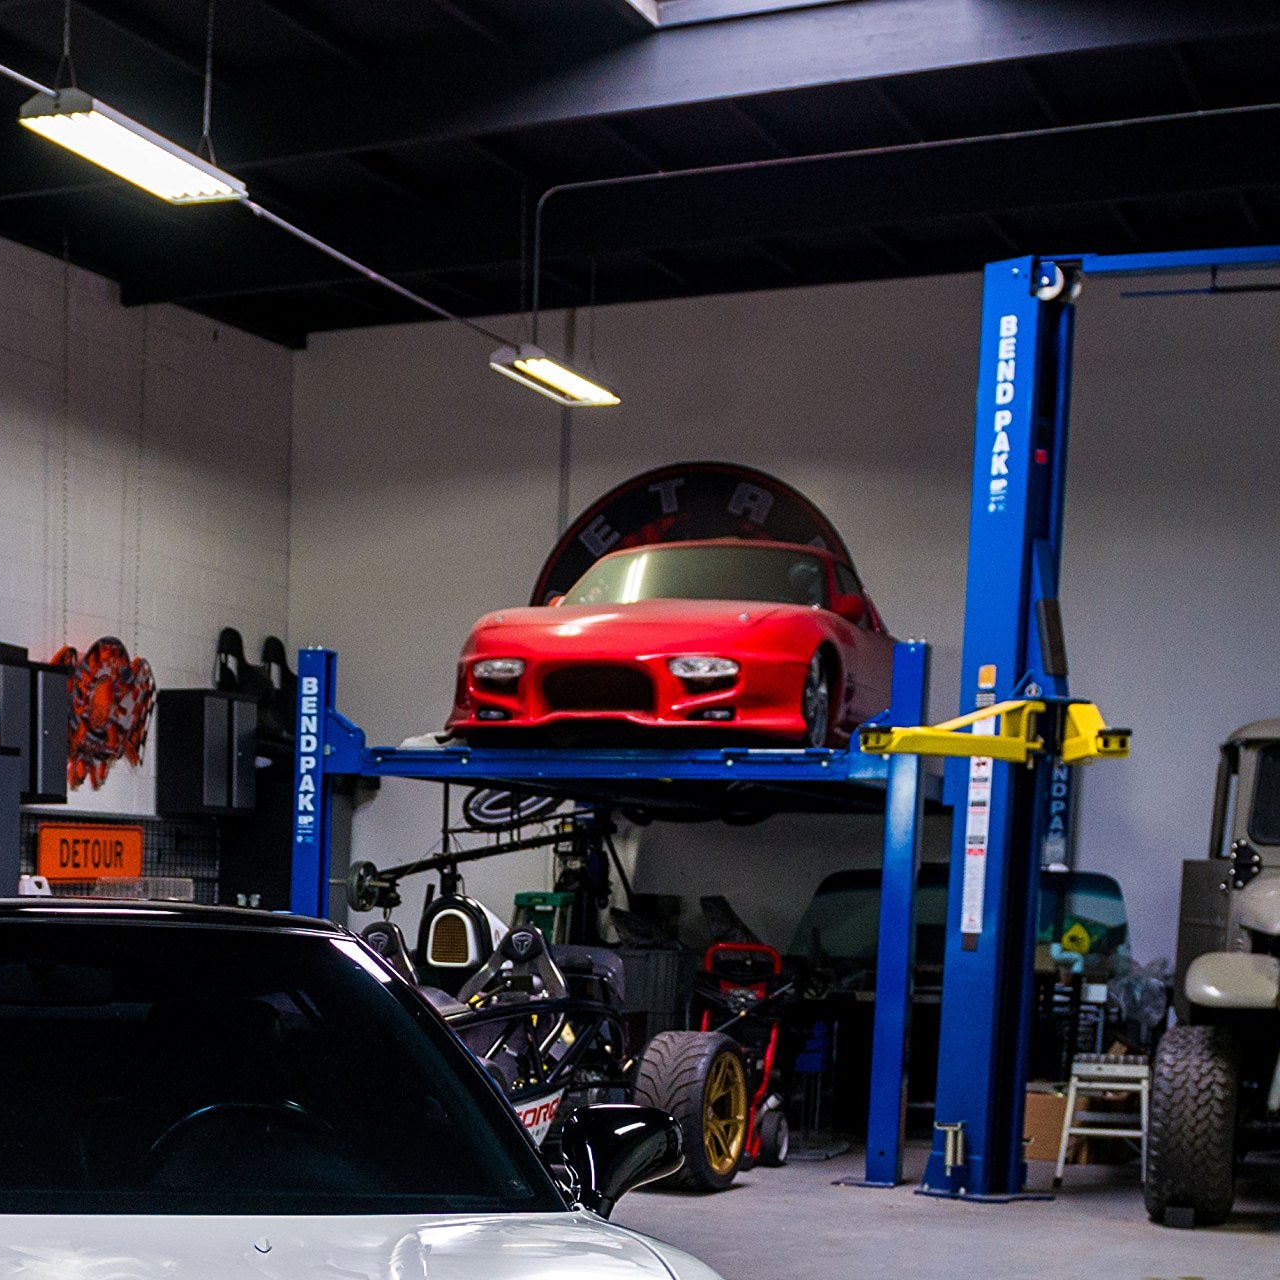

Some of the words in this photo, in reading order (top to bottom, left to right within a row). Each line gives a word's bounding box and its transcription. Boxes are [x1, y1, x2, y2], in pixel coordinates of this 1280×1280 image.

[991, 315, 1018, 475] BENDPAK
[298, 677, 318, 811] BENDPAK
[60, 838, 124, 868] DETOUR
